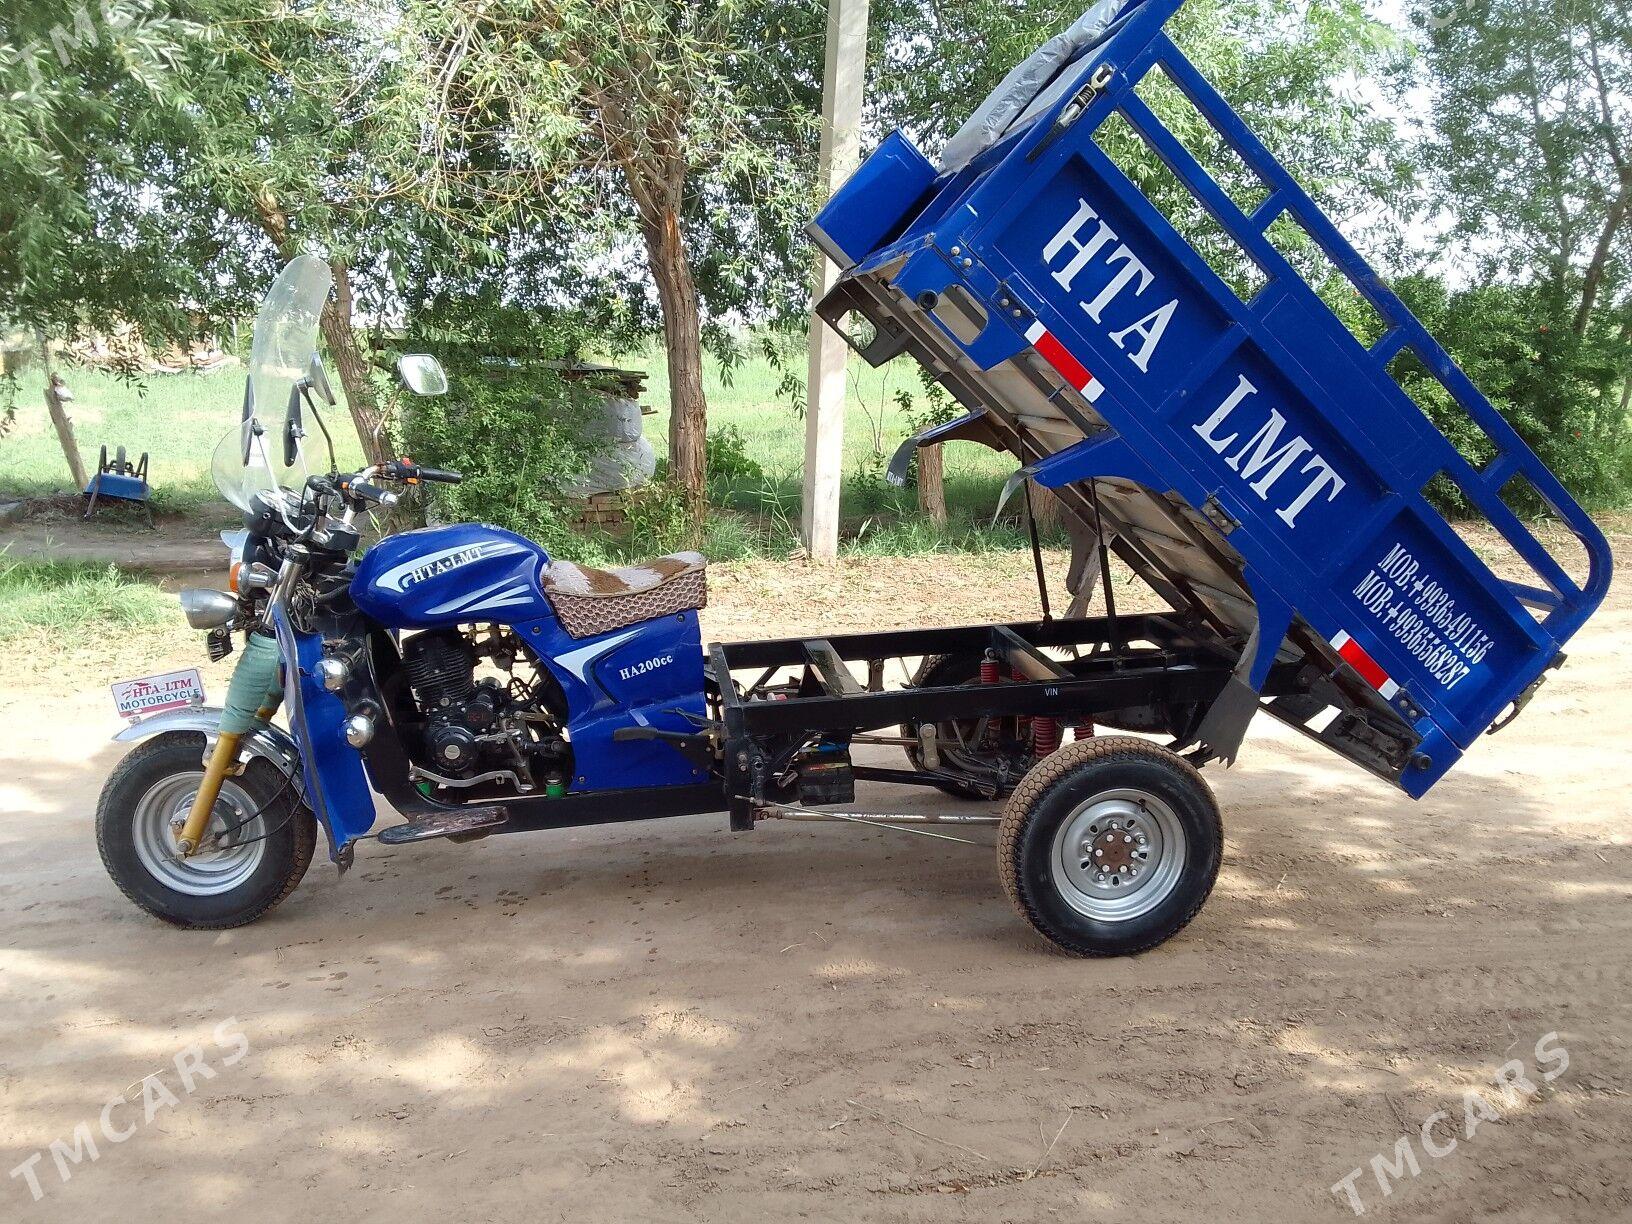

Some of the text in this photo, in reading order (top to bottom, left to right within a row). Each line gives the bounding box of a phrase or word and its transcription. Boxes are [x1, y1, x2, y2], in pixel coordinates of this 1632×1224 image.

[1043, 198, 1346, 529] HTA LMT
[619, 655, 673, 680] HA200cc
[133, 678, 192, 698] HTA-LTM
[1044, 687, 1058, 697] VIN
